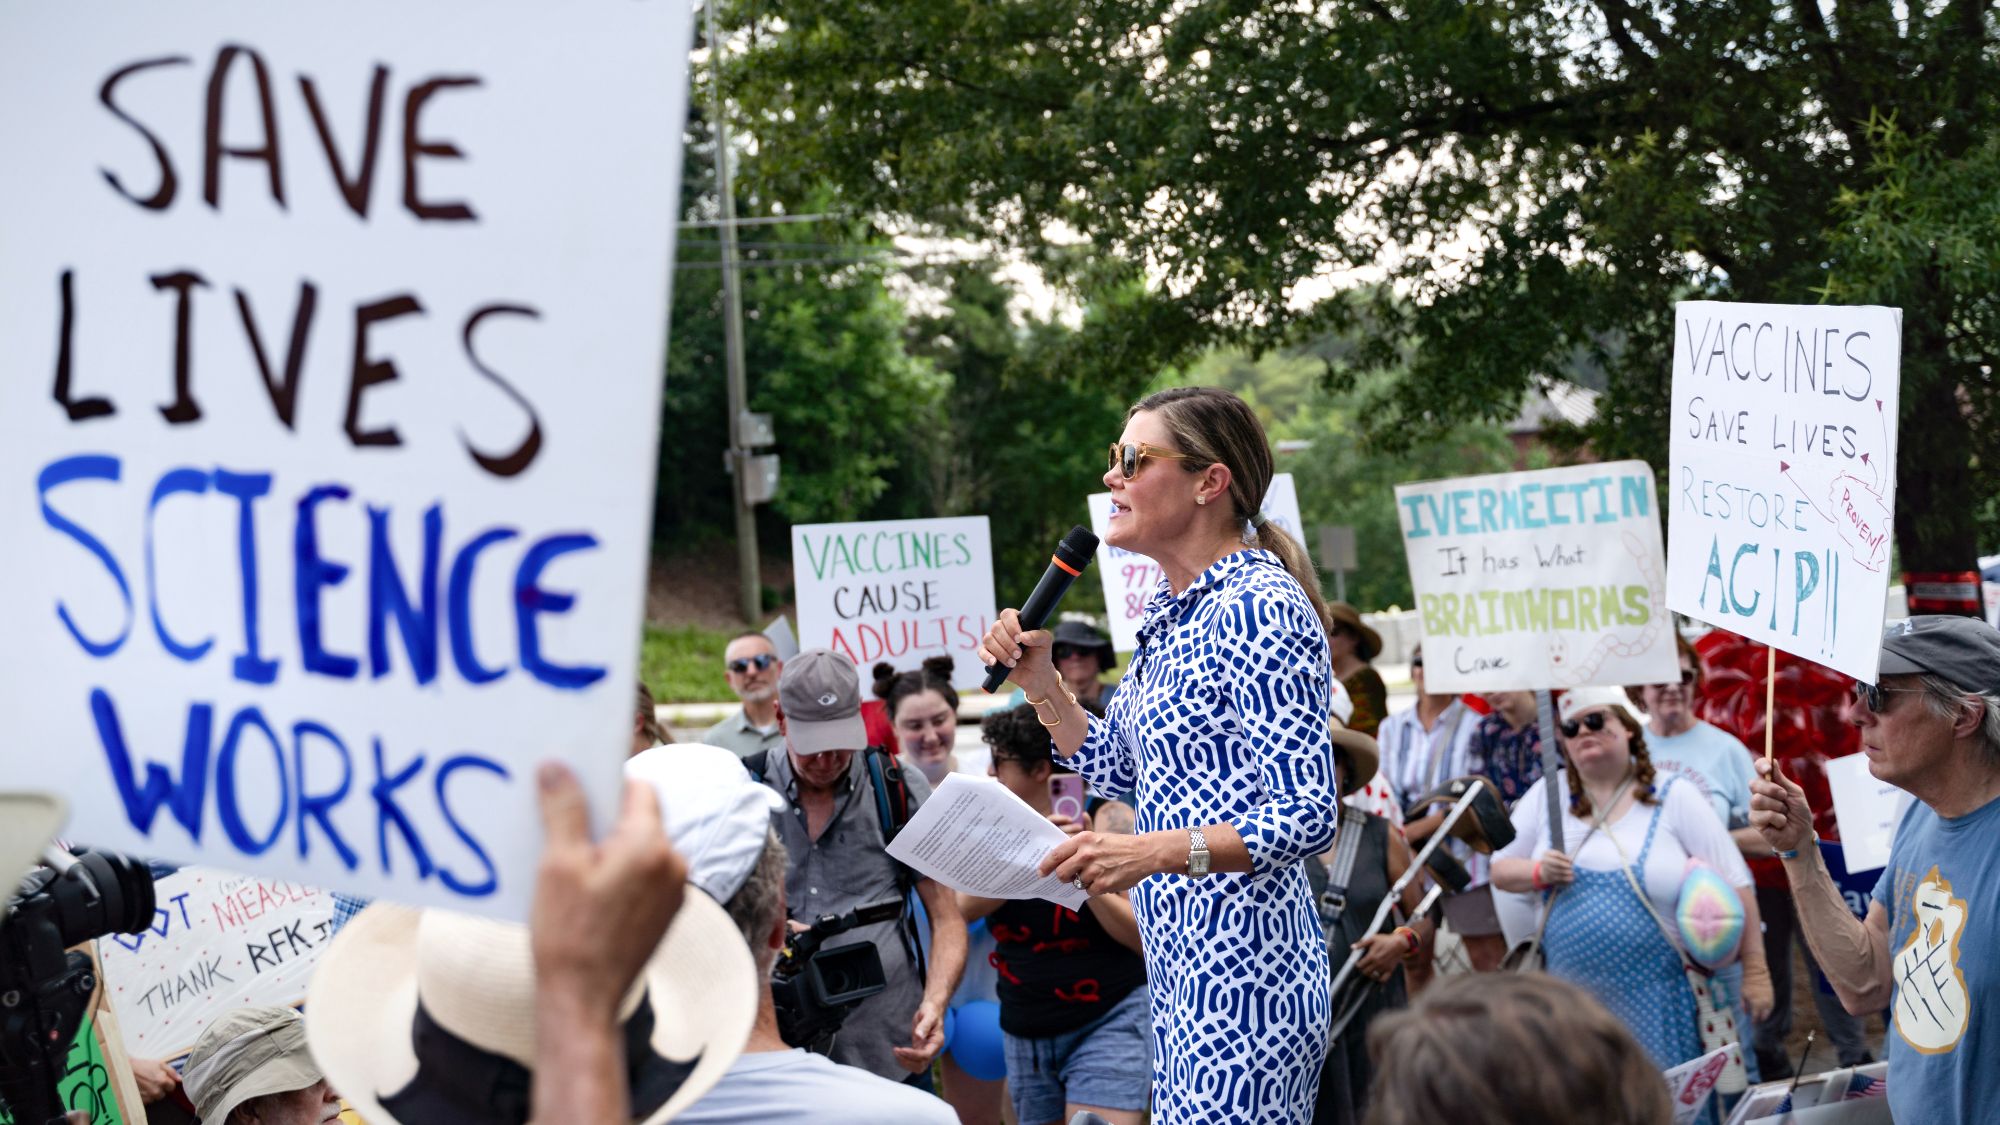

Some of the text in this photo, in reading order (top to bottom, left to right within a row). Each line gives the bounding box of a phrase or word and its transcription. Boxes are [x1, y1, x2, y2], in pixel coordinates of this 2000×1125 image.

[98, 42, 486, 223] SAVE
[53, 267, 544, 479] LIVES
[1685, 317, 1872, 402] VACCINES
[1688, 396, 1857, 459] SAVE LIVES
[1402, 476, 1650, 539] IVERMECTIN
[1682, 466, 1809, 532] RESTORE
[1841, 488, 1884, 565] PROVEN!
[38, 455, 607, 688] SCIENCE
[803, 531, 972, 580] VACCINES
[1438, 544, 1585, 576] It has What
[834, 580, 940, 619] CAUSE
[1420, 585, 1650, 637] BRAINWORMS
[1699, 533, 1839, 659] ACIP!!
[1454, 646, 1510, 675] Crave
[90, 687, 512, 897] WORKS
[137, 918, 332, 1016] THANK RFK J
